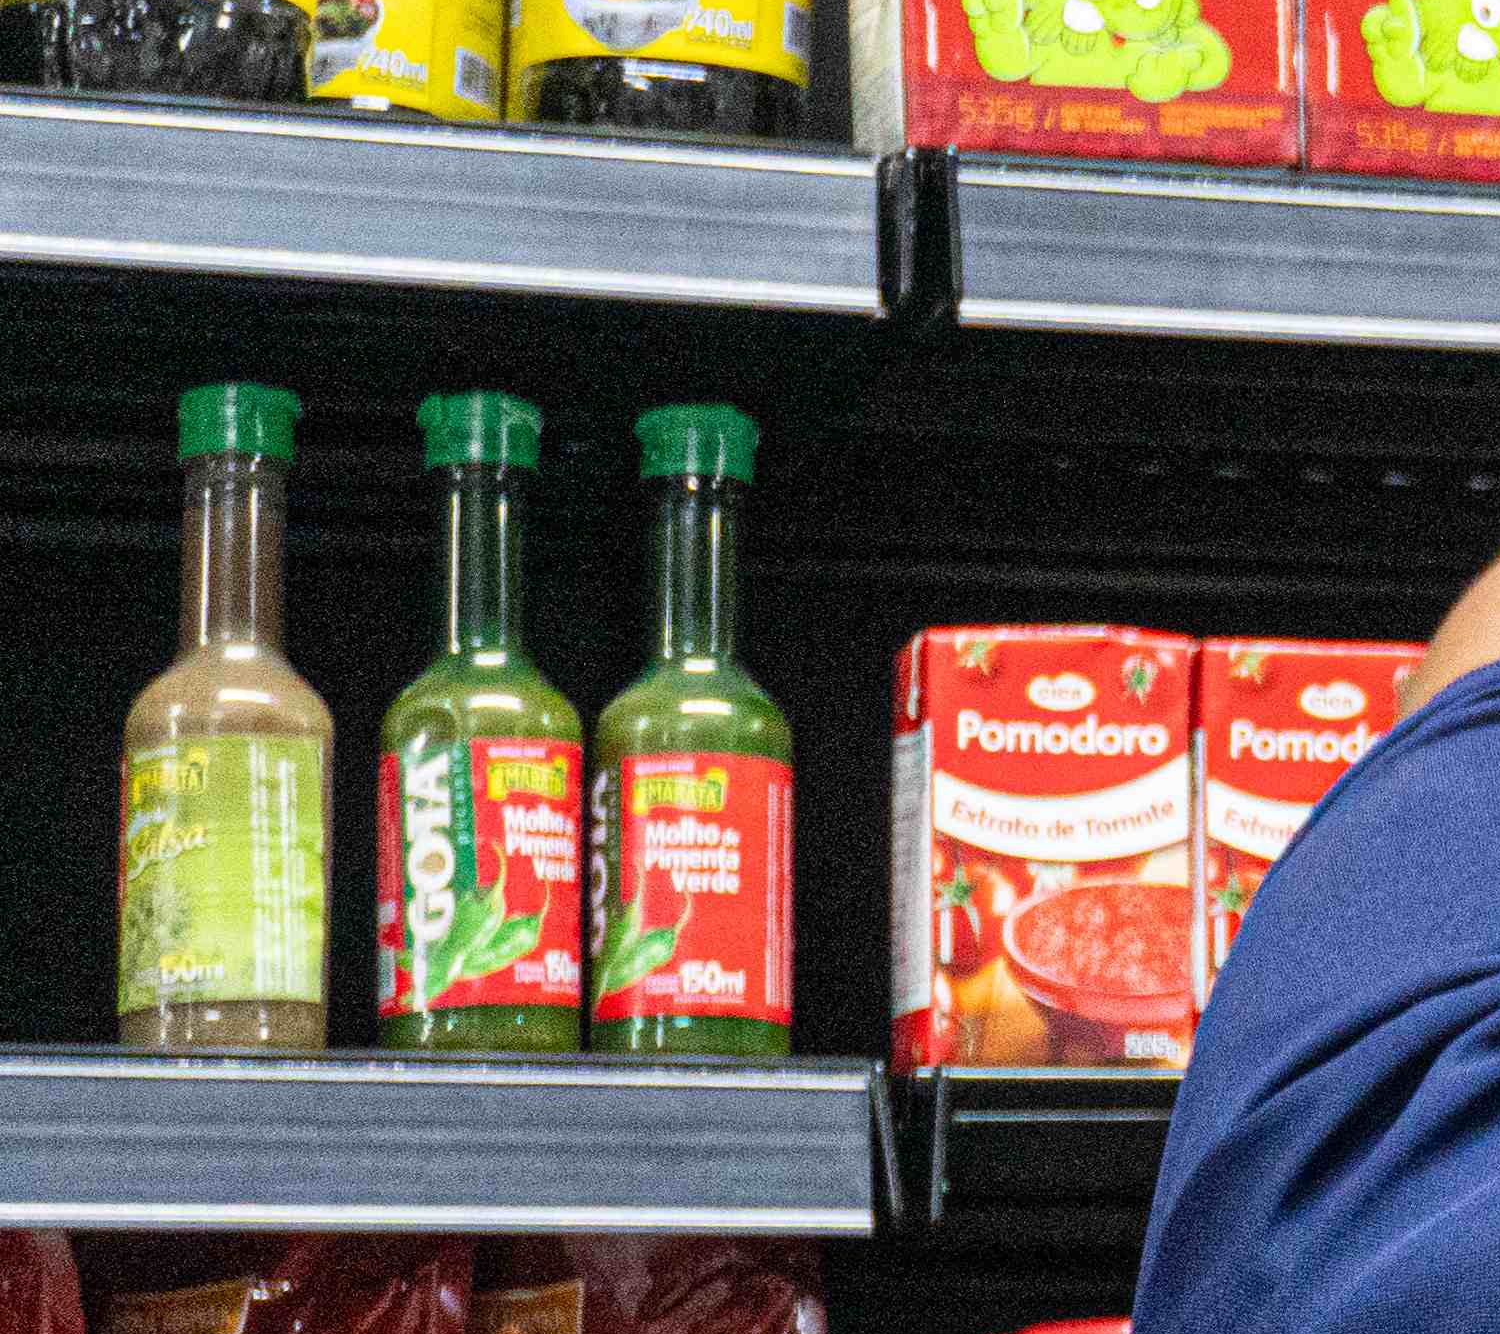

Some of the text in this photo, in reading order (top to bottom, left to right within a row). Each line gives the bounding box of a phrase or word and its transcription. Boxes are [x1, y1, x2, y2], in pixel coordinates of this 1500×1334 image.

[957, 709, 1170, 757] Pomodoro
[644, 817, 721, 847] Molho
[951, 797, 1175, 840] Extrato de Tomate
[405, 749, 454, 943] GOTA
[644, 845, 742, 873] Pimenta
[671, 869, 742, 896] Verde
[680, 959, 747, 996] 150ml
